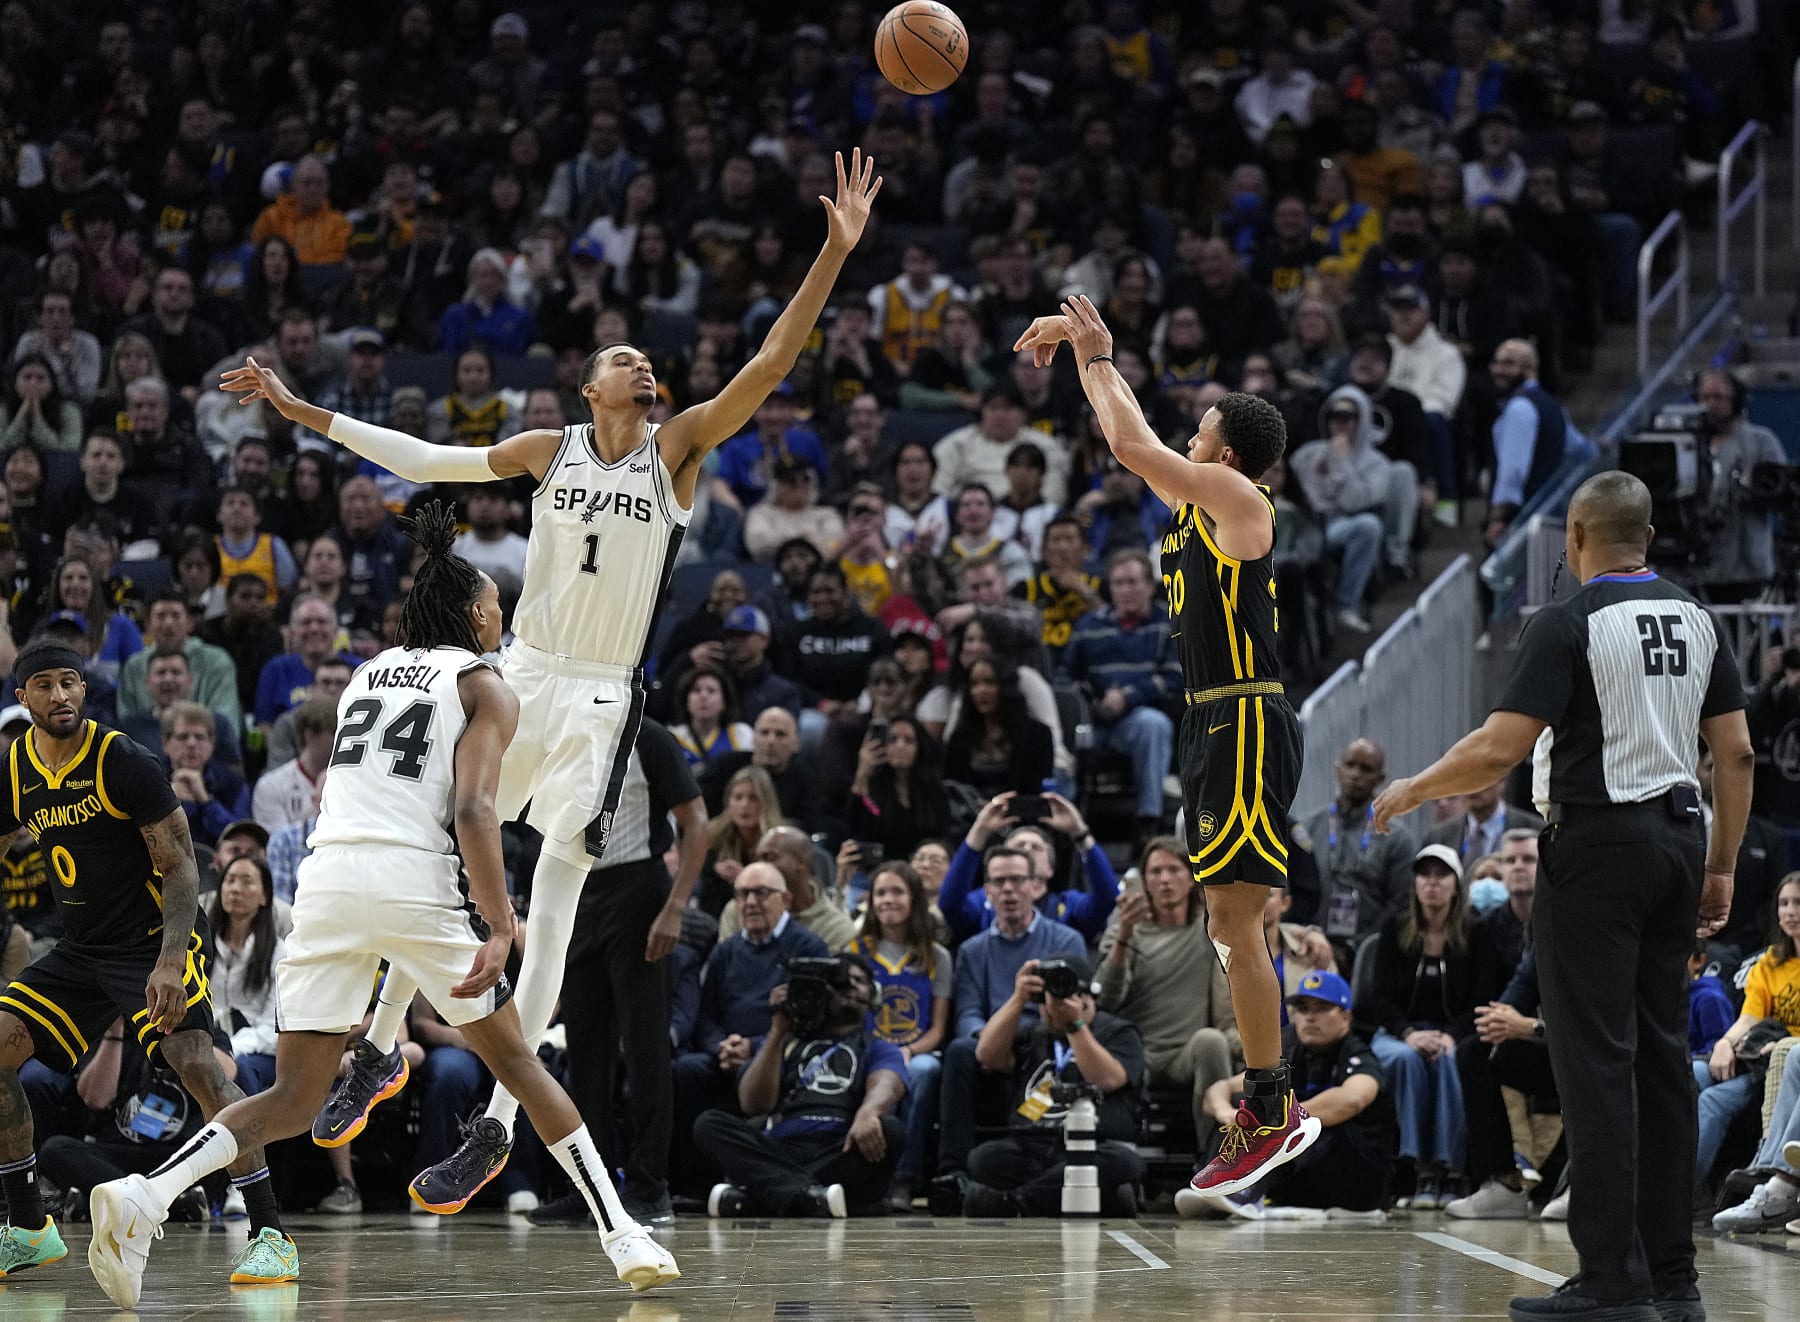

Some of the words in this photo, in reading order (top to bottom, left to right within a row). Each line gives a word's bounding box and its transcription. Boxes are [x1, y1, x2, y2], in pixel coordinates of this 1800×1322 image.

[553, 488, 652, 524] SPURS
[579, 532, 600, 576] 1
[1636, 614, 1687, 677] 25
[368, 665, 441, 694] VASSELL
[328, 696, 438, 784] 24
[66, 779, 94, 790] Rakuten
[34, 794, 102, 831] FRANCISCO
[51, 845, 77, 888] 0
